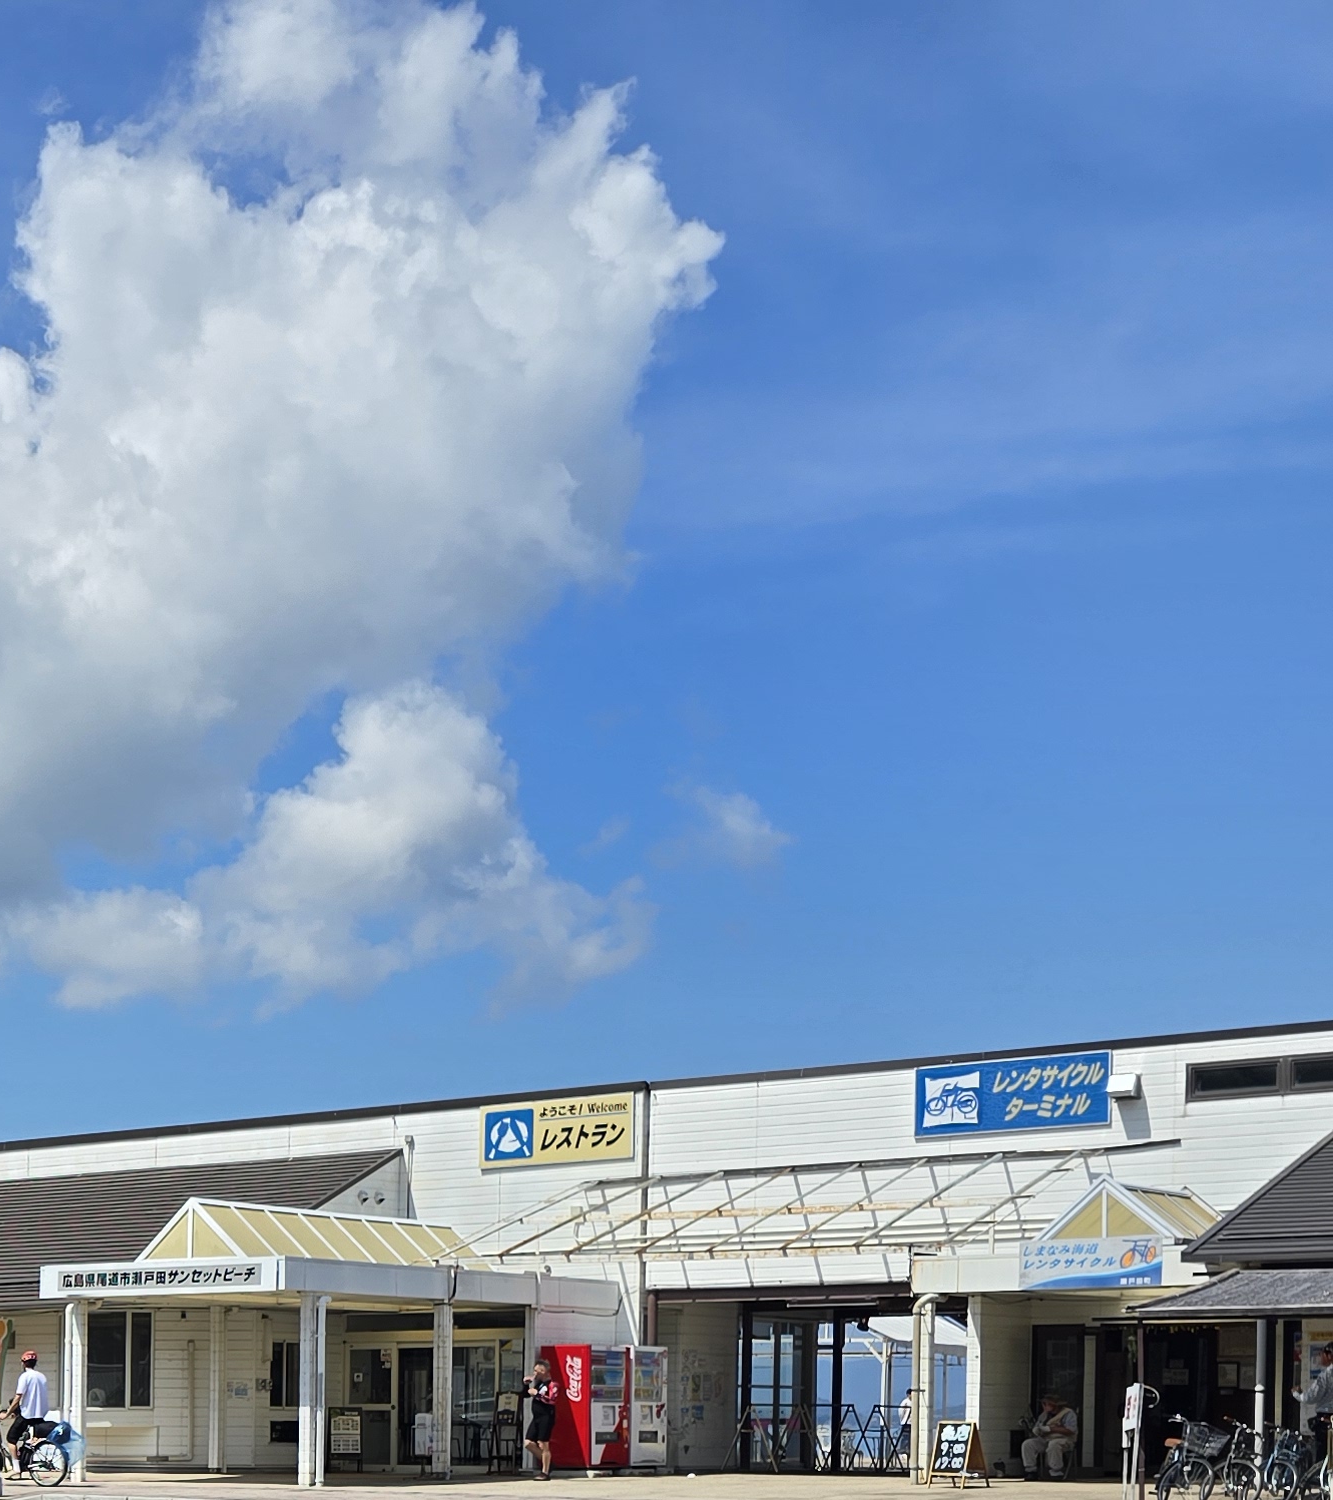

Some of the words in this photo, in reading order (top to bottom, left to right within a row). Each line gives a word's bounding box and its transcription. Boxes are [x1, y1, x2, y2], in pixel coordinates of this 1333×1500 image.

[992, 1062, 1105, 1093] レンタサイクル
[587, 1101, 628, 1114] Welcome
[1004, 1093, 1091, 1121] ターミナル
[540, 1124, 626, 1151] レストラン
[1023, 1243, 1099, 1257] しまなみ海道
[1024, 1256, 1117, 1270] レンタサイクル
[62, 1266, 257, 1288] 広島県尾道市瀬戸田サンセットビーチ
